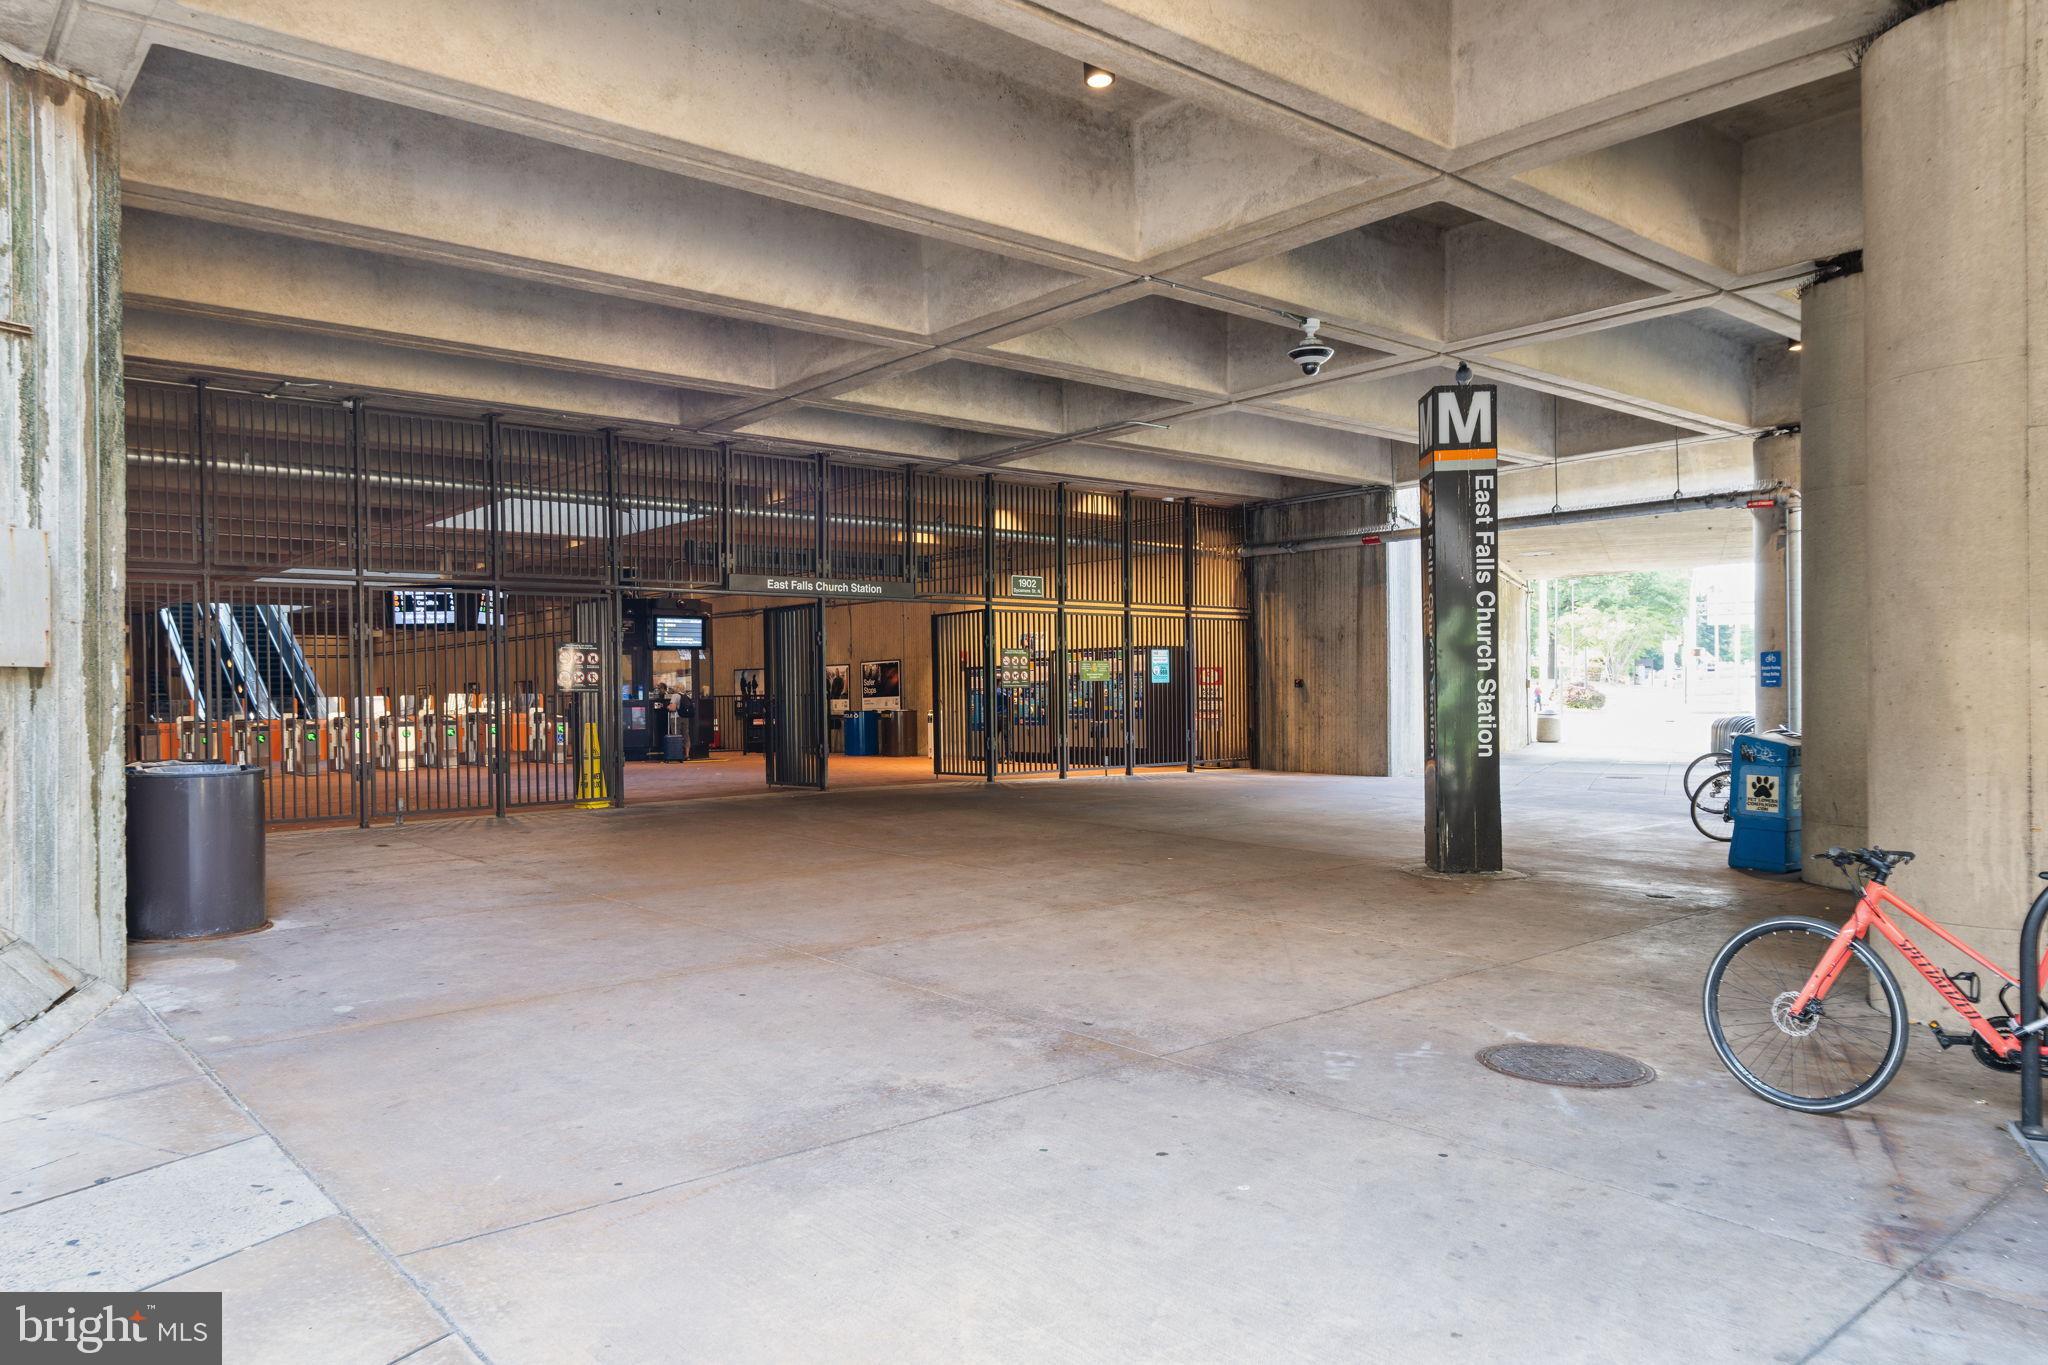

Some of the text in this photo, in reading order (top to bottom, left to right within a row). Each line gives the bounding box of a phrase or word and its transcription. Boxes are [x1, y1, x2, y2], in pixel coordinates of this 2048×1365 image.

[1419, 395, 1433, 453] M
[1438, 391, 1492, 444] M
[767, 579, 882, 594] East Falls Church Station
[1018, 579, 1037, 587] 1902
[1475, 475, 1497, 757] East Falls Church Station
[864, 687, 877, 695] Stops
[1899, 939, 1982, 1019] SPECIALIZED
